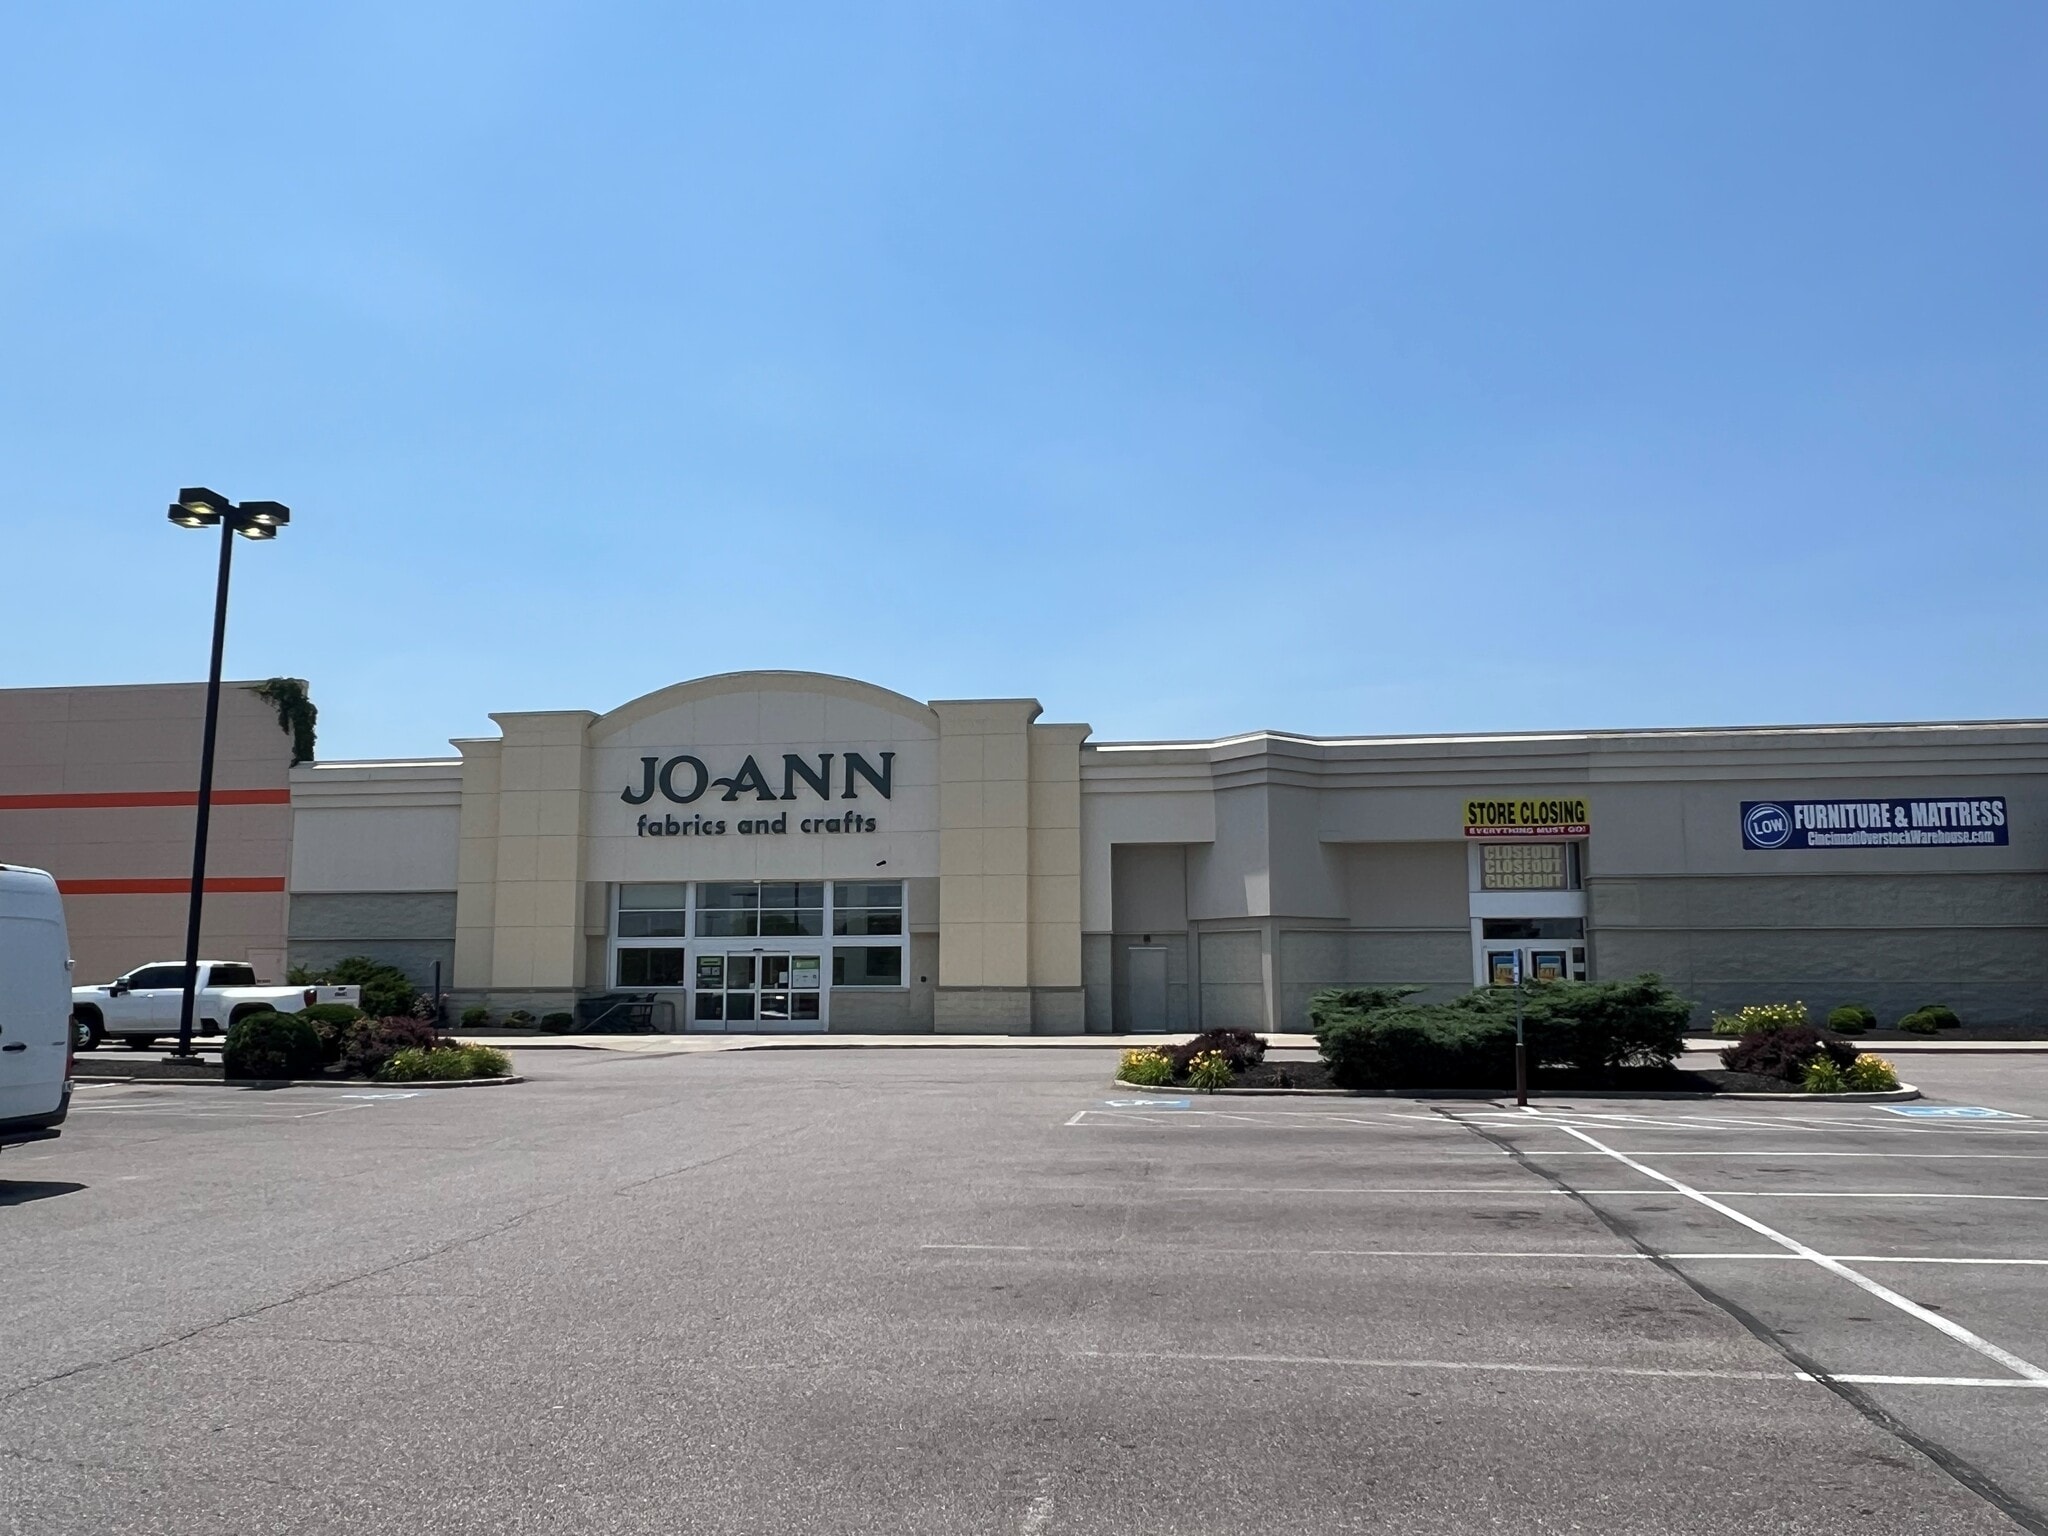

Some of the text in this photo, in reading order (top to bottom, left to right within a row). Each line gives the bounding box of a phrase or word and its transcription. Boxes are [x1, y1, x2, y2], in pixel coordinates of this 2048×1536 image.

[1468, 800, 1585, 825] STORE CLOSING
[1794, 800, 2005, 829] FURNITURE & MATTRESS
[637, 810, 877, 837] fabrics and crafts
[1469, 827, 1534, 835] EVERYTHING
[1536, 826, 1565, 834] MUST
[1753, 818, 1783, 835] LOW
[1484, 845, 1563, 860] CLOSEOUT
[1484, 859, 1563, 874] CLOSEOUT
[1484, 873, 1564, 888] CLOSEOUT
